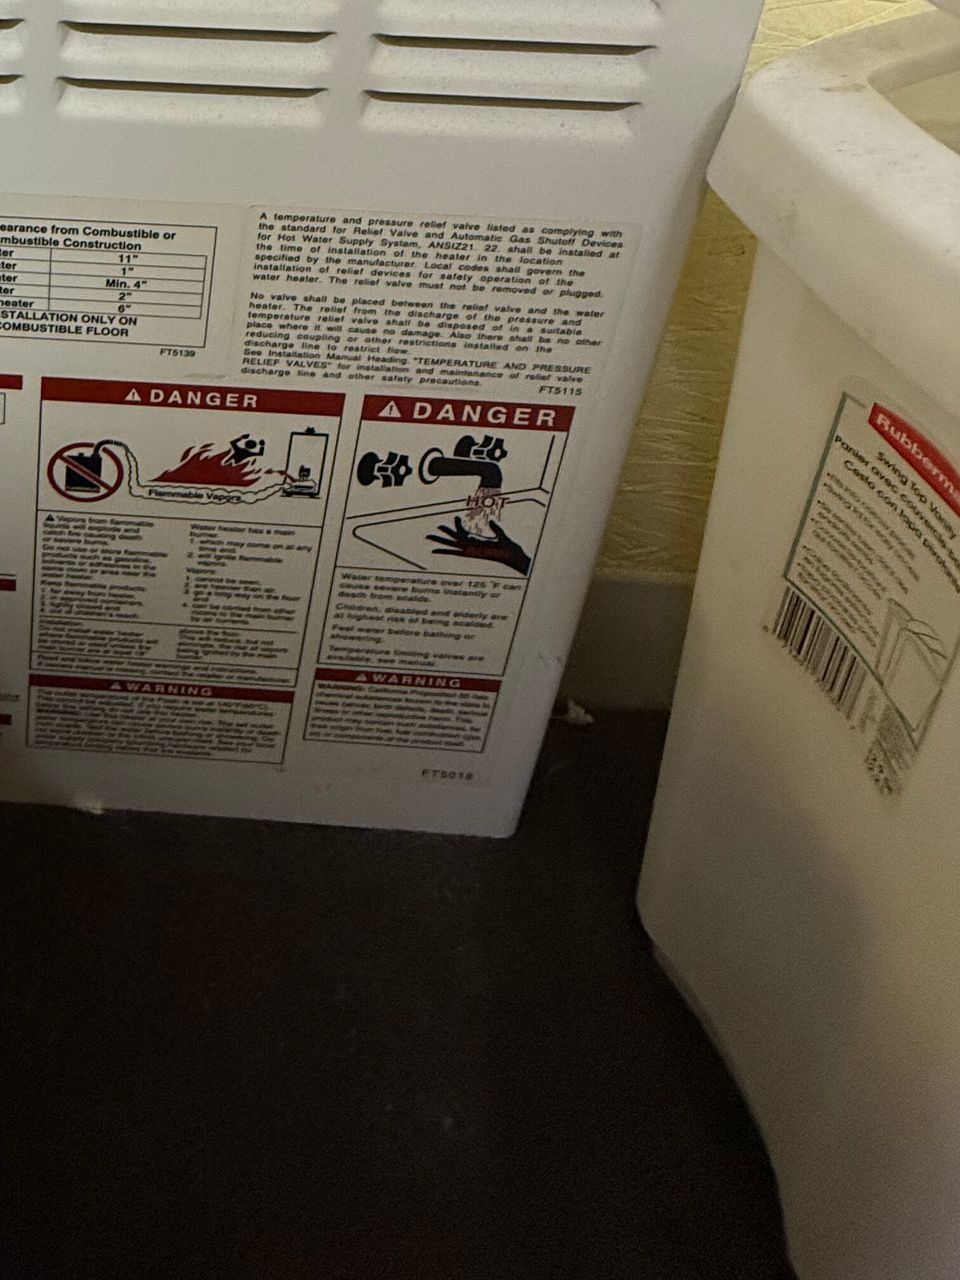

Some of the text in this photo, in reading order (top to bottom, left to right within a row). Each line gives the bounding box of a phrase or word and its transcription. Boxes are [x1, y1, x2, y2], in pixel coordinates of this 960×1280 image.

[50, 224, 79, 235] from
[82, 226, 159, 239] Combustible
[162, 232, 176, 240] or
[62, 237, 141, 250] Construction
[105, 278, 130, 288] Min.
[80, 314, 116, 324] ONLY
[118, 316, 138, 325] ON
[85, 326, 129, 336] FLOOR
[149, 389, 258, 408] DANGER
[412, 402, 556, 426] DANGER
[148, 488, 203, 500] Flammable
[466, 495, 508, 509] HOT
[372, 674, 462, 688] WARNING
[123, 681, 212, 696] WARNING
